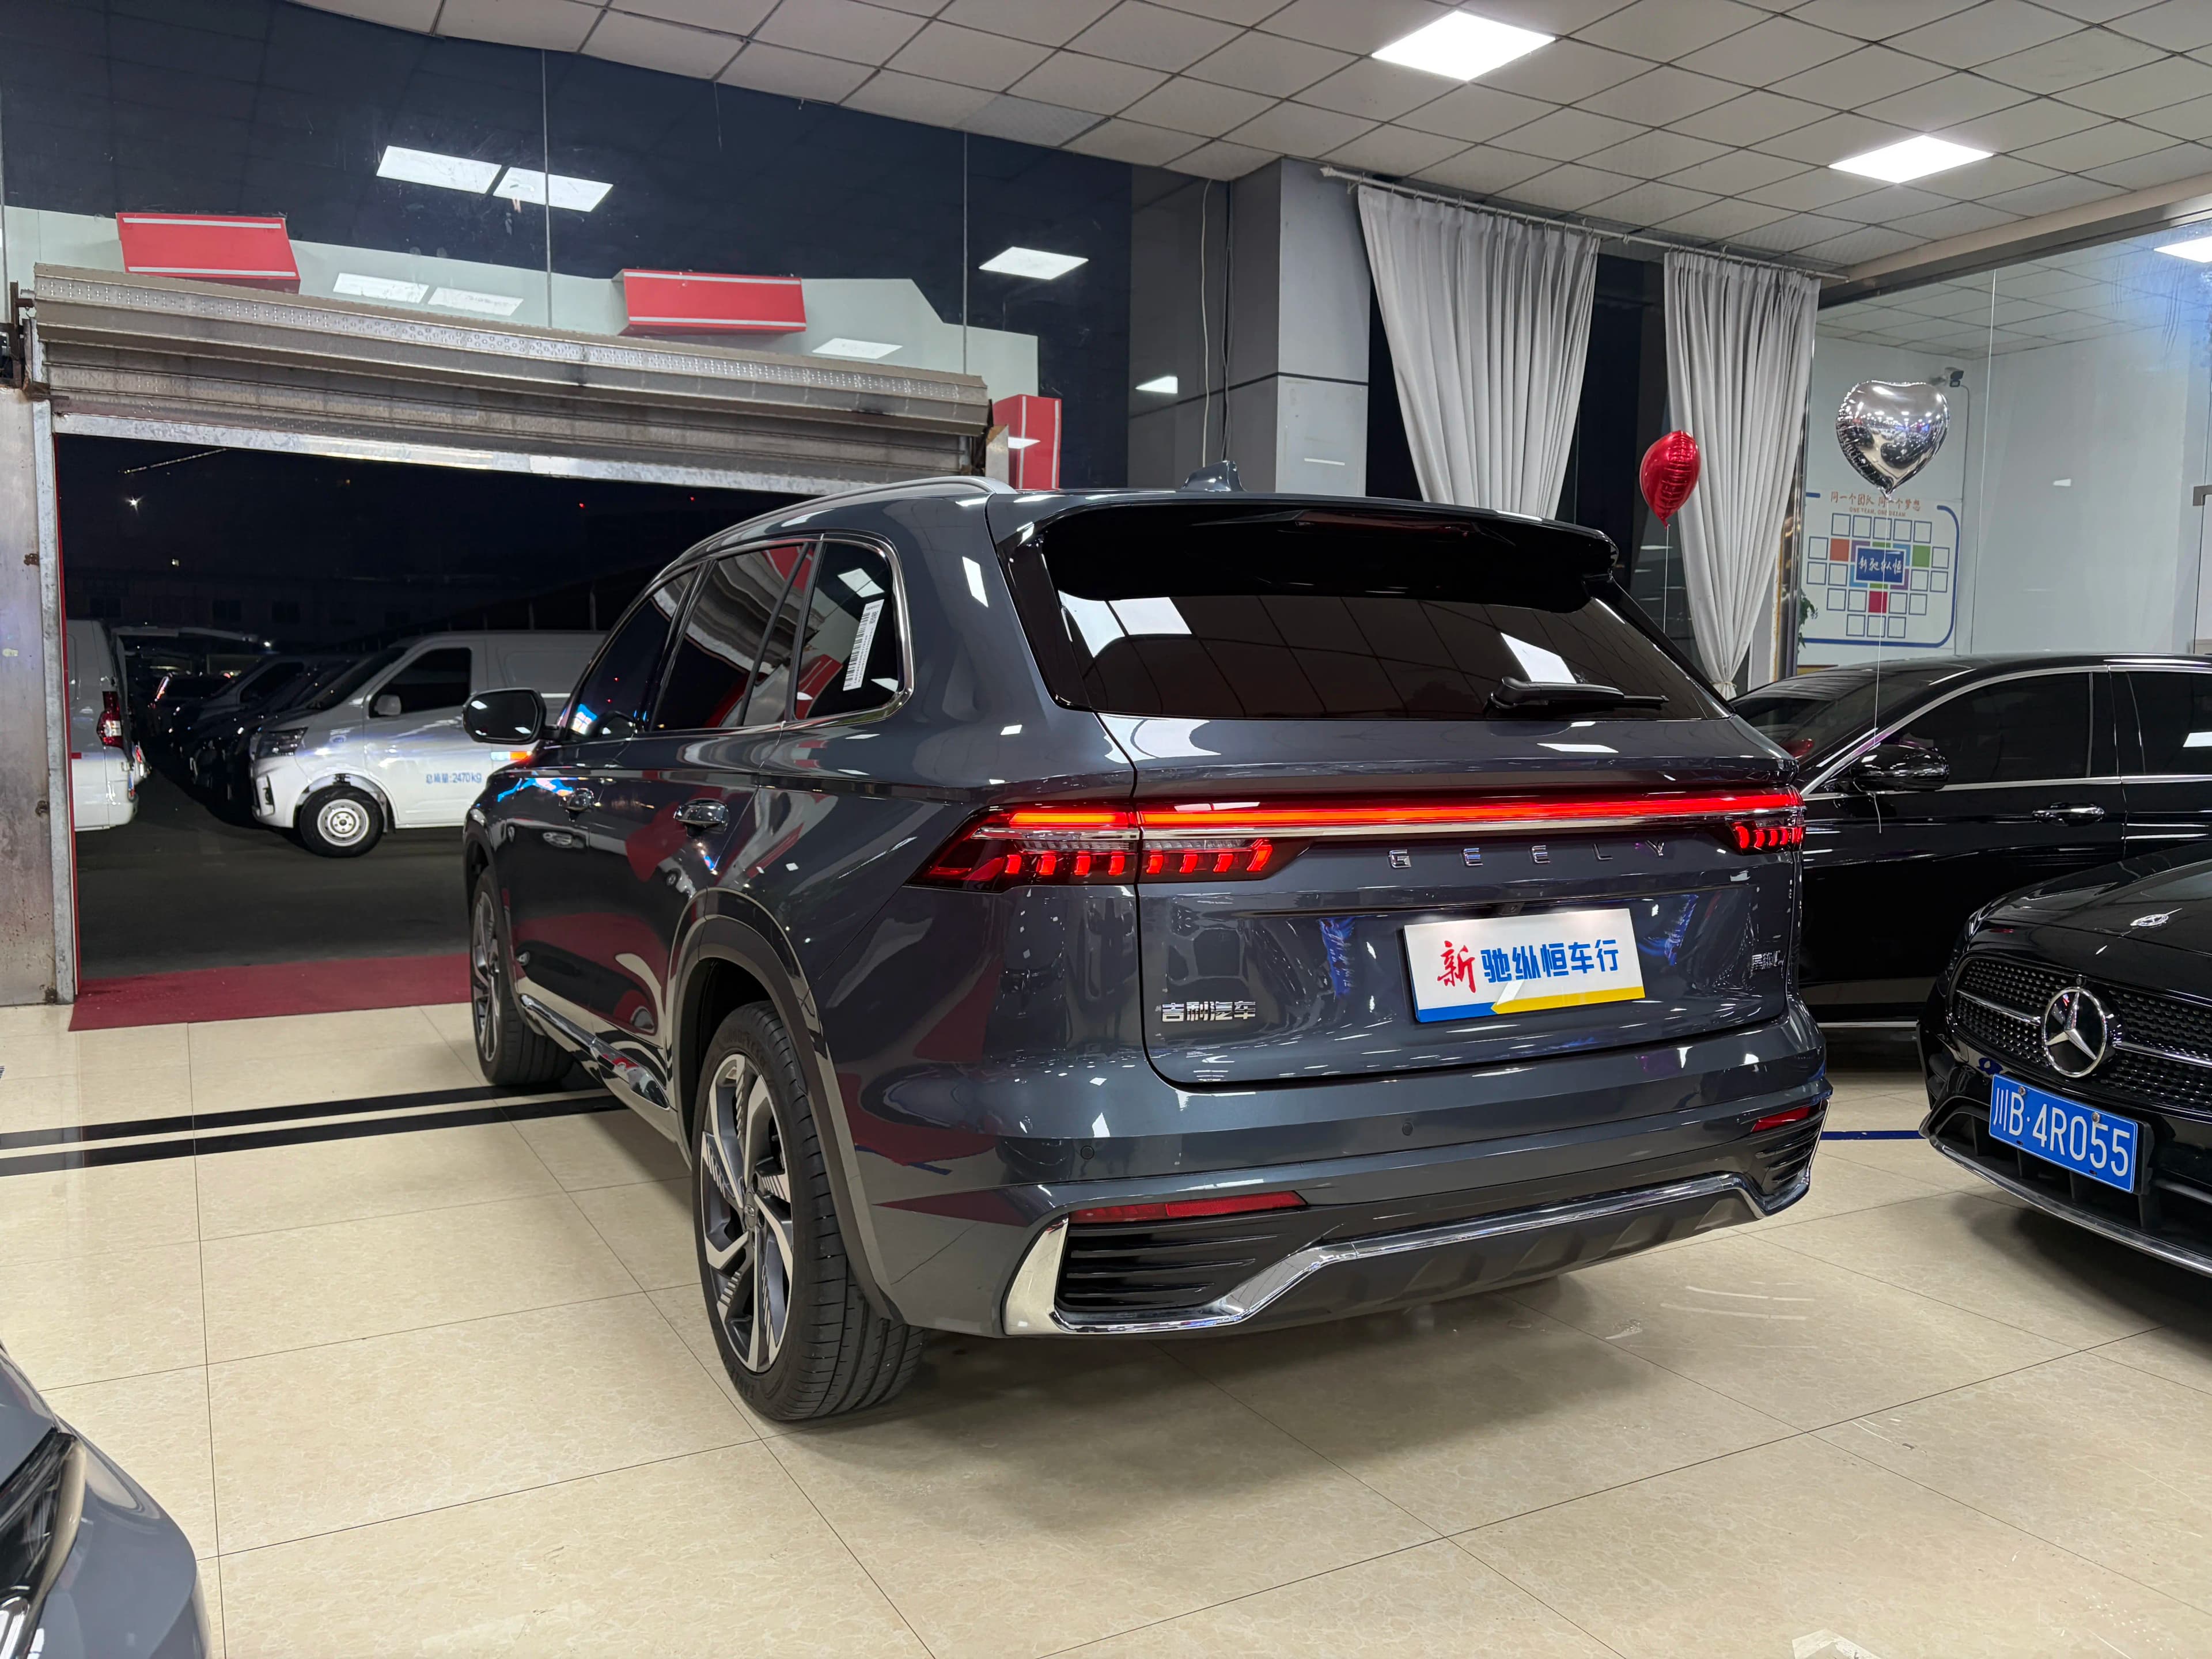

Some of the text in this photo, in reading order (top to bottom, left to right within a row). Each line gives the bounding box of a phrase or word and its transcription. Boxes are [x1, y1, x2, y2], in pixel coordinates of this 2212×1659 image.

[1831, 491, 1921, 512] 同一个团队 同一个梦想
[1388, 839, 1665, 869] GEELY
[1437, 939, 1619, 993] 新驰纵恒车行
[1162, 1001, 1256, 1022] 吉利汽车
